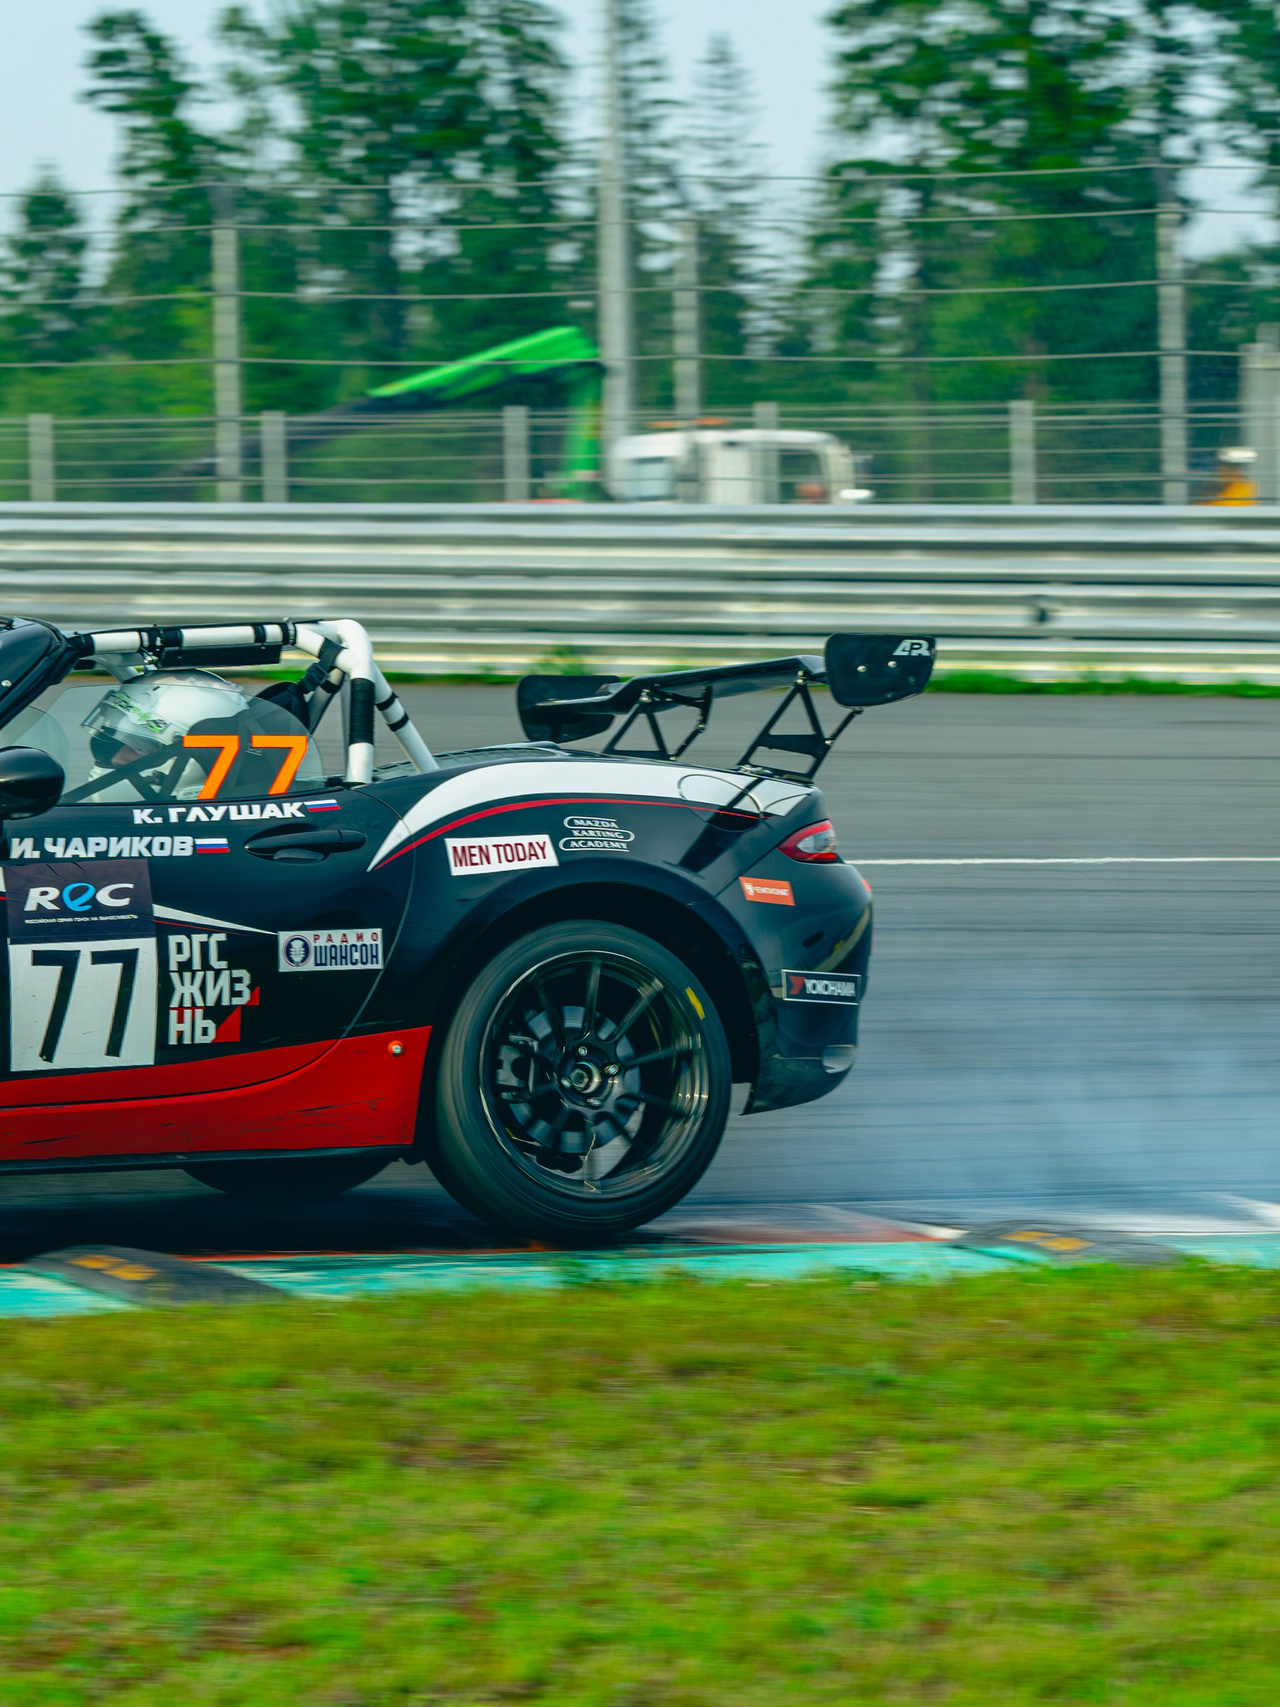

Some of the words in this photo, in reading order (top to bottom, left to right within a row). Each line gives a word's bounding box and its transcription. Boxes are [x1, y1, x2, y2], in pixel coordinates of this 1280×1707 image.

[182, 735, 308, 800] 77
[132, 807, 163, 824] К.
[168, 802, 306, 823] ГЛУШАК
[573, 819, 620, 829] MAZDA
[569, 840, 628, 849] ACADEMY
[571, 830, 624, 839] KARTING
[10, 837, 40, 859] И.
[44, 836, 194, 859] ЧАРИКОВ
[452, 845, 491, 867] MEN
[492, 841, 547, 864] TODAY
[313, 931, 379, 944] РАДИО
[168, 933, 228, 971] РГС
[313, 943, 380, 967] ШАНСОН
[168, 969, 252, 1008] ЖИЗ
[803, 978, 856, 997] YOKOHAMA
[31, 948, 140, 1063] 77
[168, 1008, 218, 1045] НЬ
